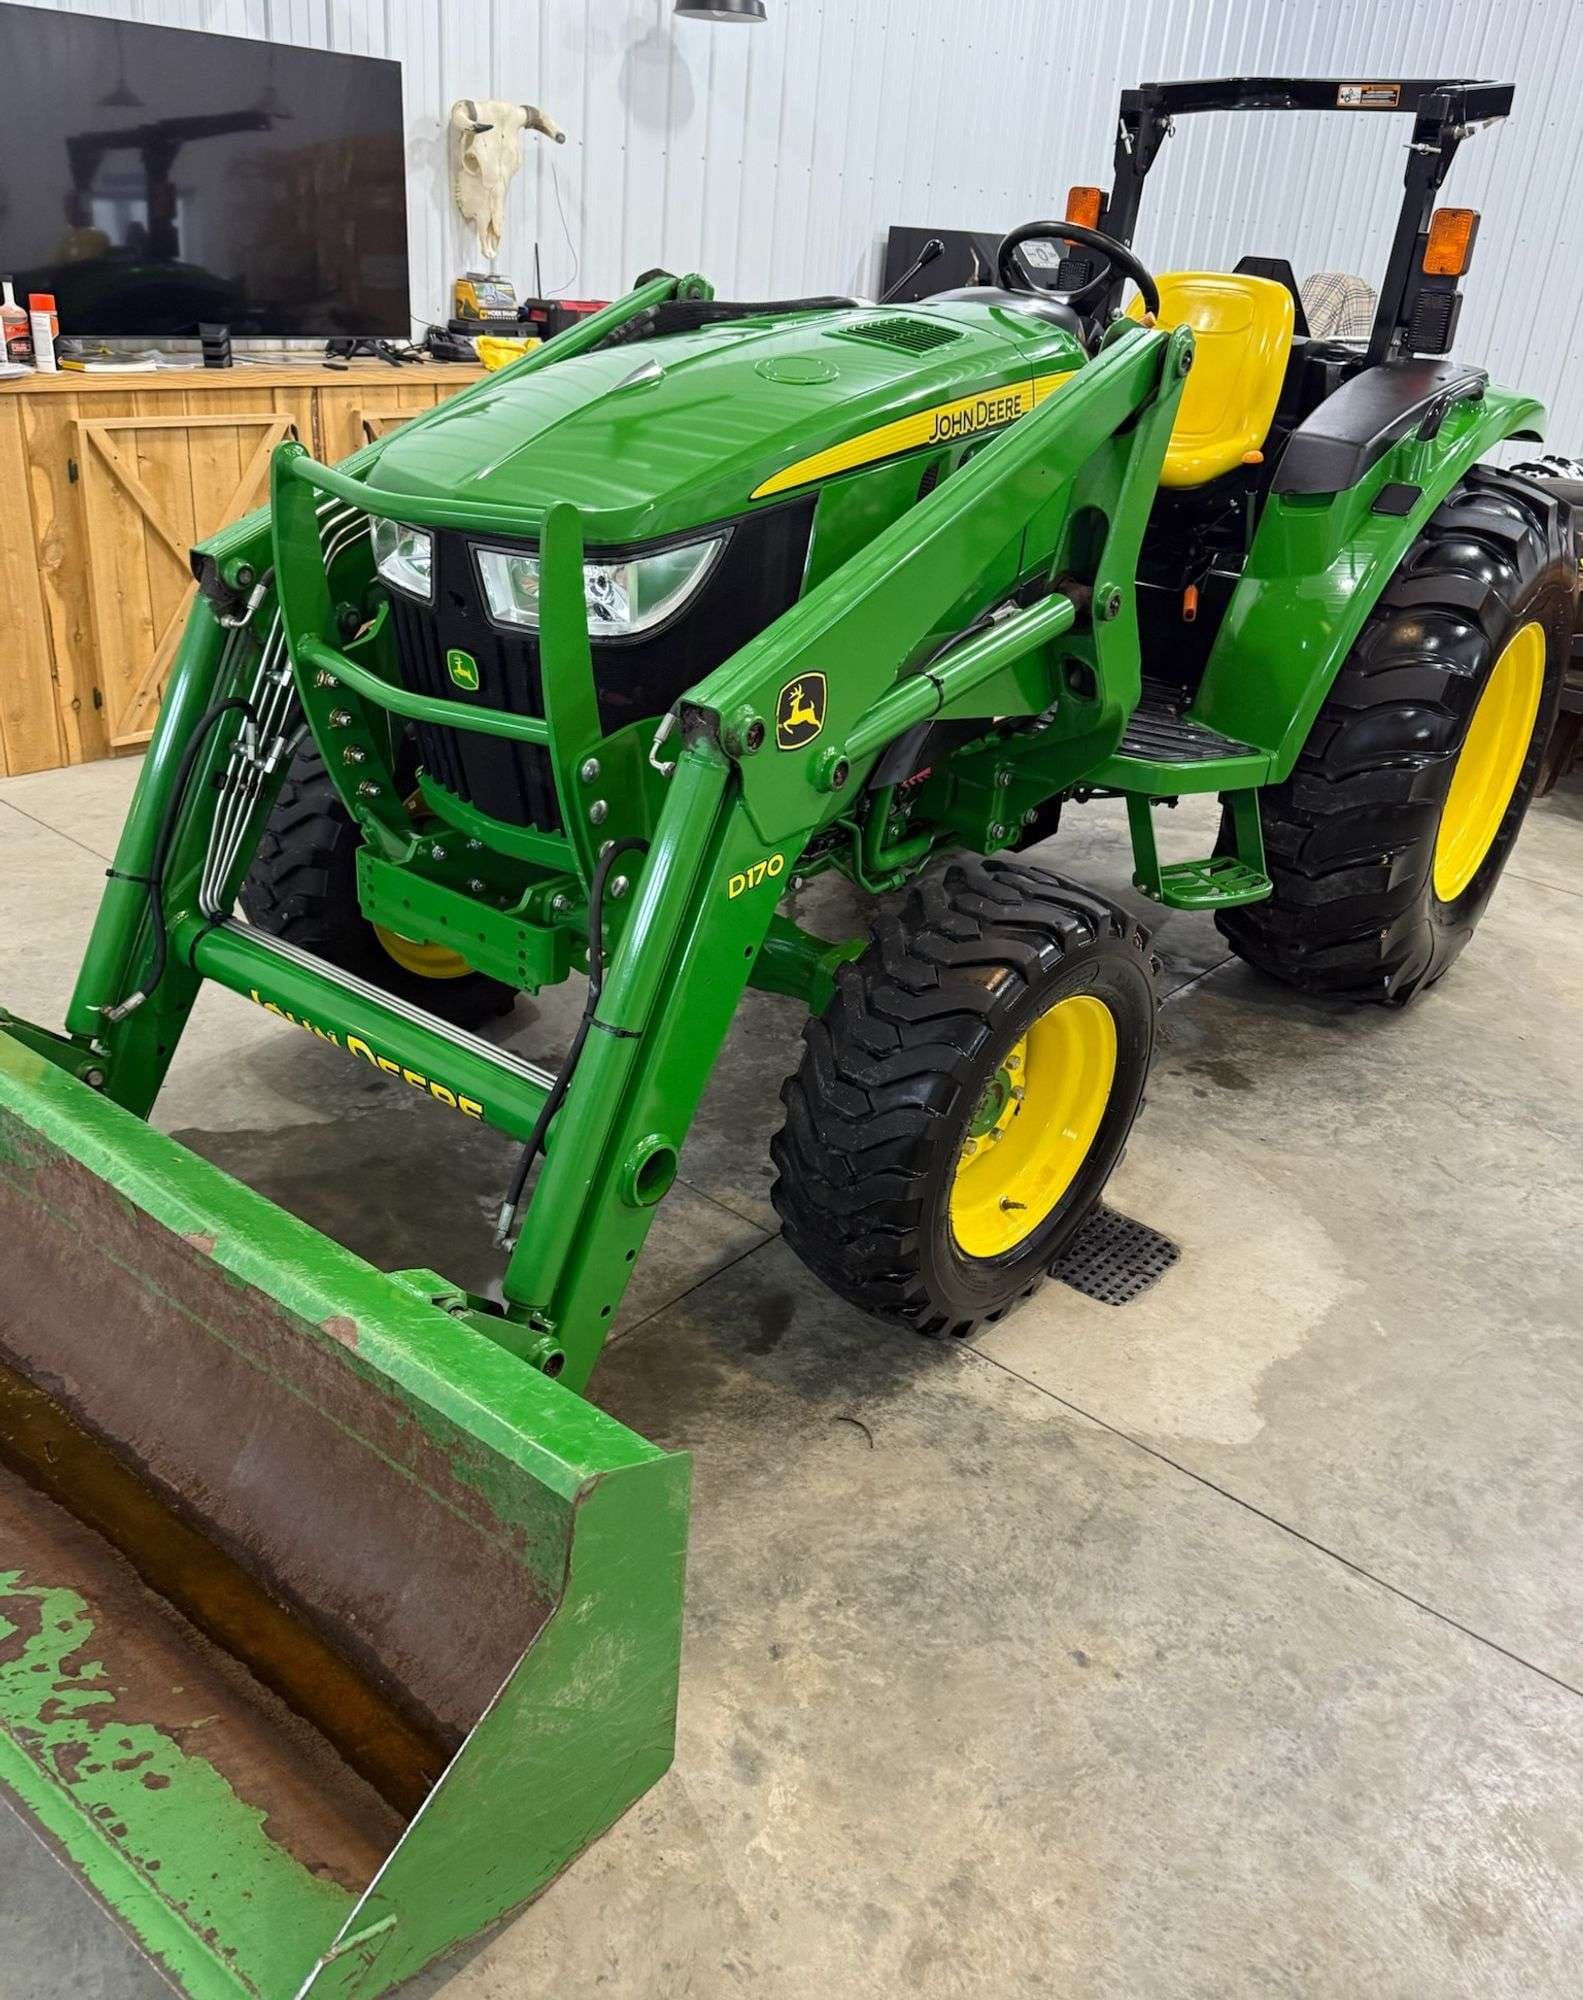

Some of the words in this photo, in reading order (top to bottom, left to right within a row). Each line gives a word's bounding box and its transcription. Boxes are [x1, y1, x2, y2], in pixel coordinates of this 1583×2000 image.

[929, 408, 974, 442] JOHN
[976, 395, 1022, 427] DEERE
[728, 853, 784, 900] D170
